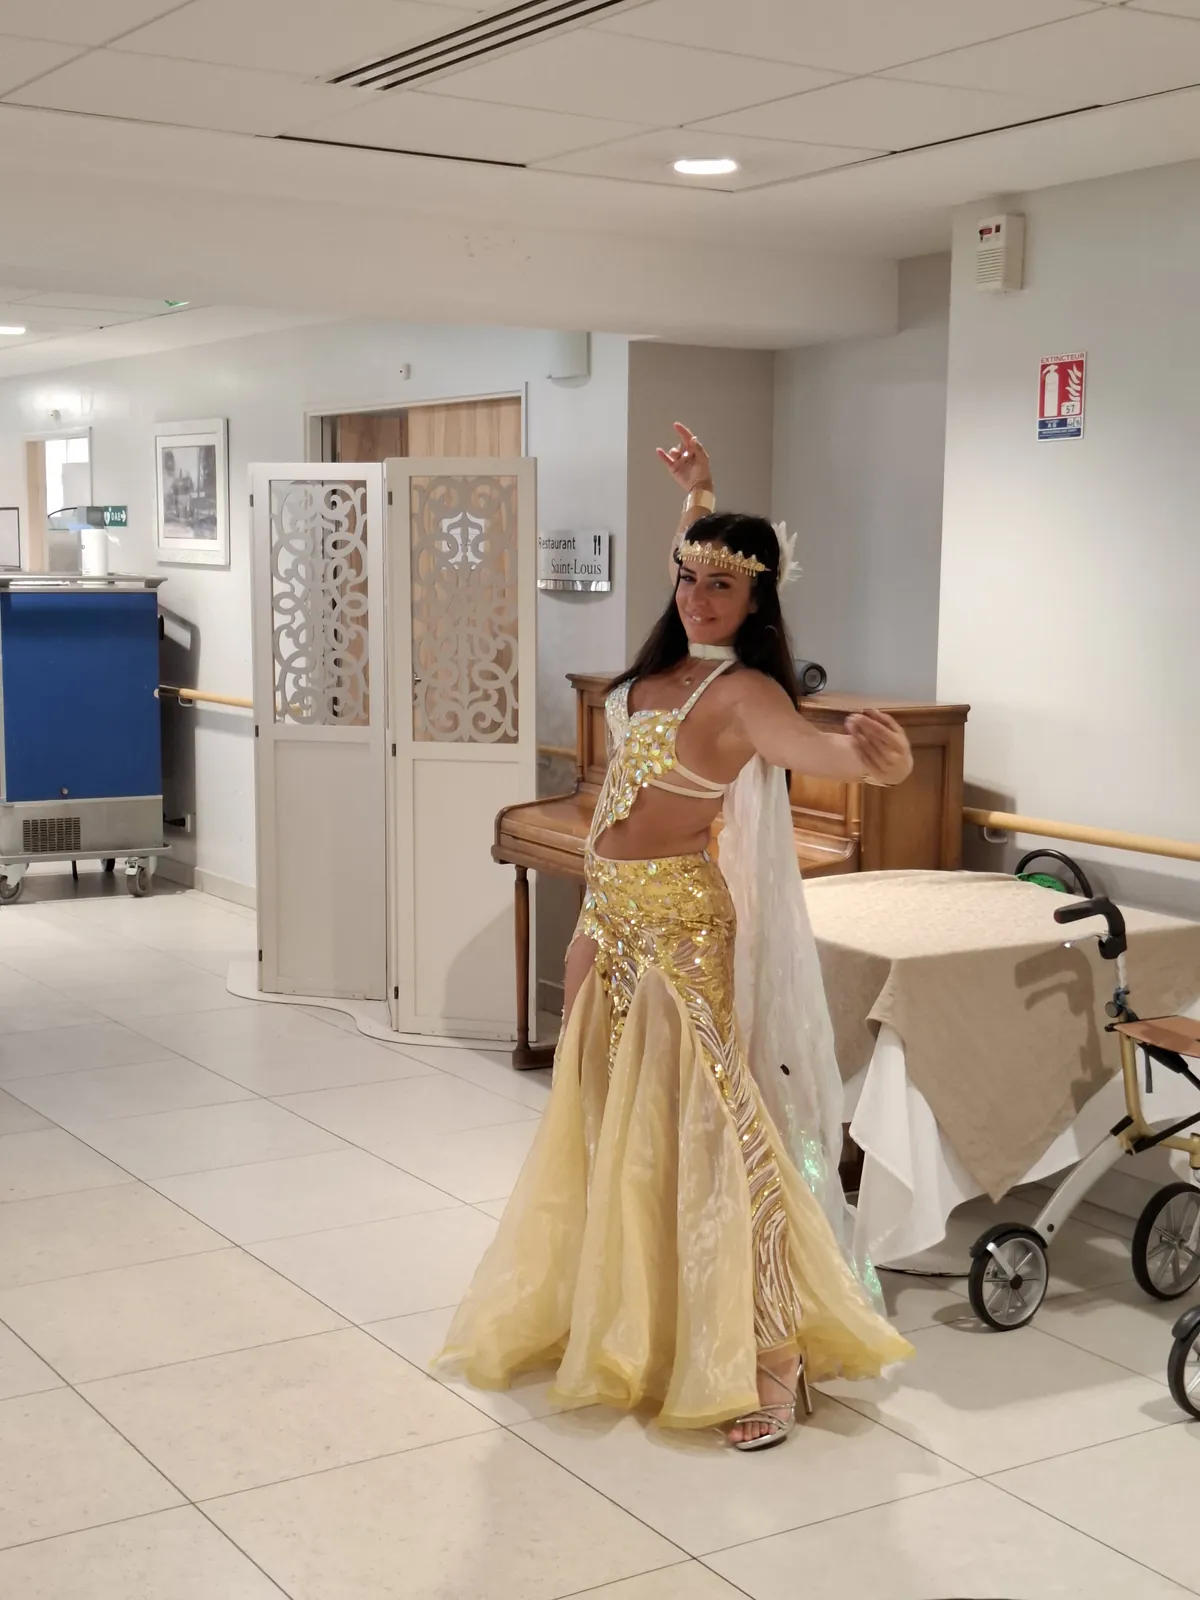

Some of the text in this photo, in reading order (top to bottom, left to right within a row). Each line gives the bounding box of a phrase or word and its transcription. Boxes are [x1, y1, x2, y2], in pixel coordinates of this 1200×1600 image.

[1041, 353, 1085, 364] EXTINCTEUR
[538, 536, 576, 550] Restaurant
[551, 558, 602, 575] Saint-Louis
